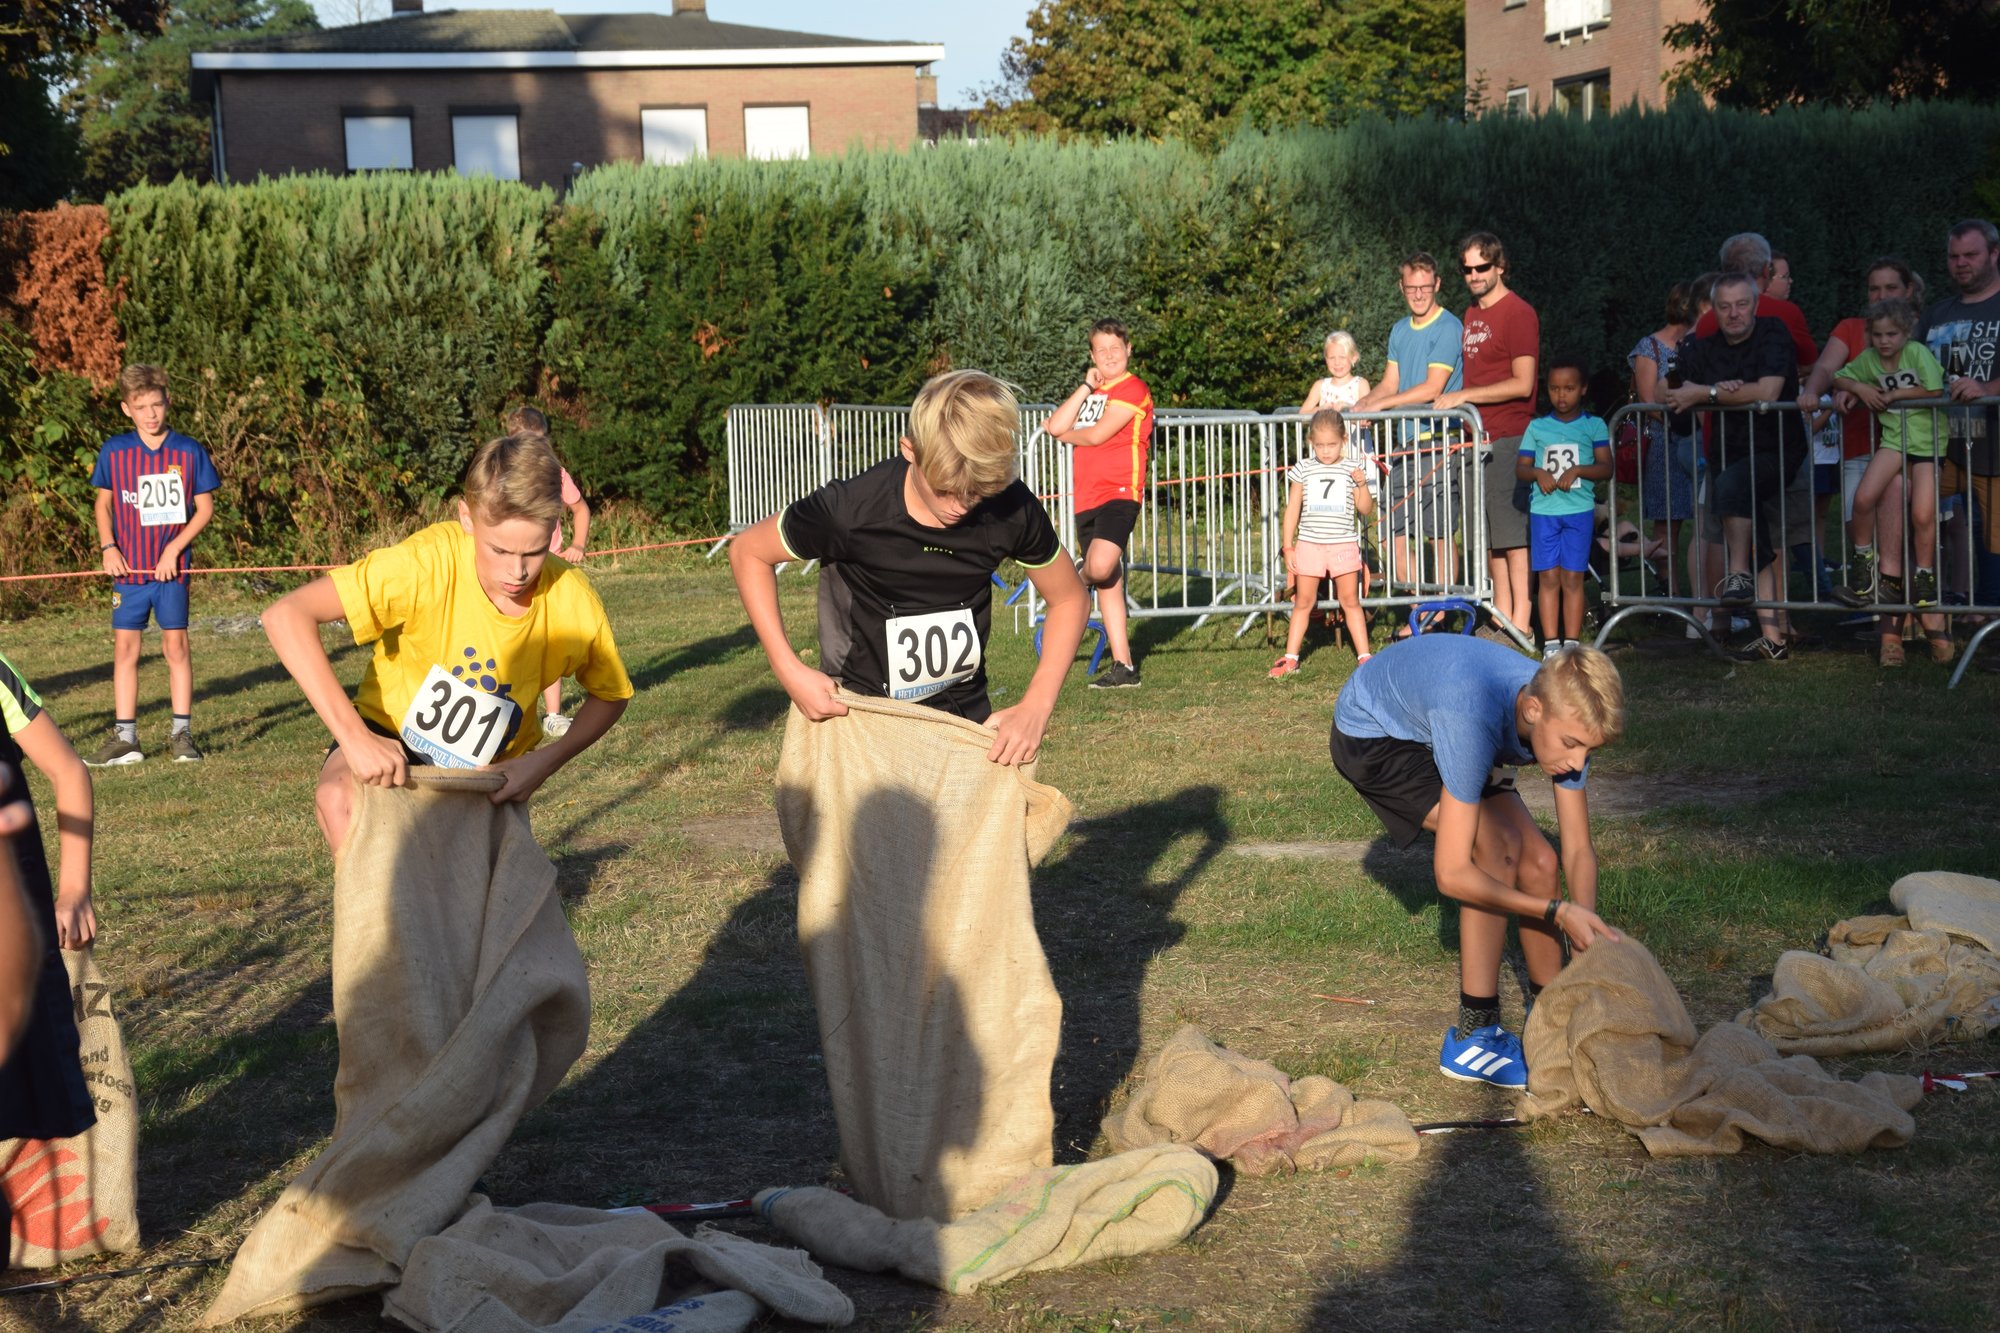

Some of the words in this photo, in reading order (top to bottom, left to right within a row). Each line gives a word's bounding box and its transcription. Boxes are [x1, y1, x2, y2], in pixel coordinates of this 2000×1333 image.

[1546, 449, 1576, 475] 53
[121, 489, 139, 504] Ra
[141, 478, 181, 508] 205
[1319, 478, 1336, 500] 7
[897, 621, 975, 683] 302
[898, 689, 913, 699] HET
[415, 679, 502, 758] 301
[405, 729, 419, 748] HET
[417, 736, 449, 766] LAATSTE
